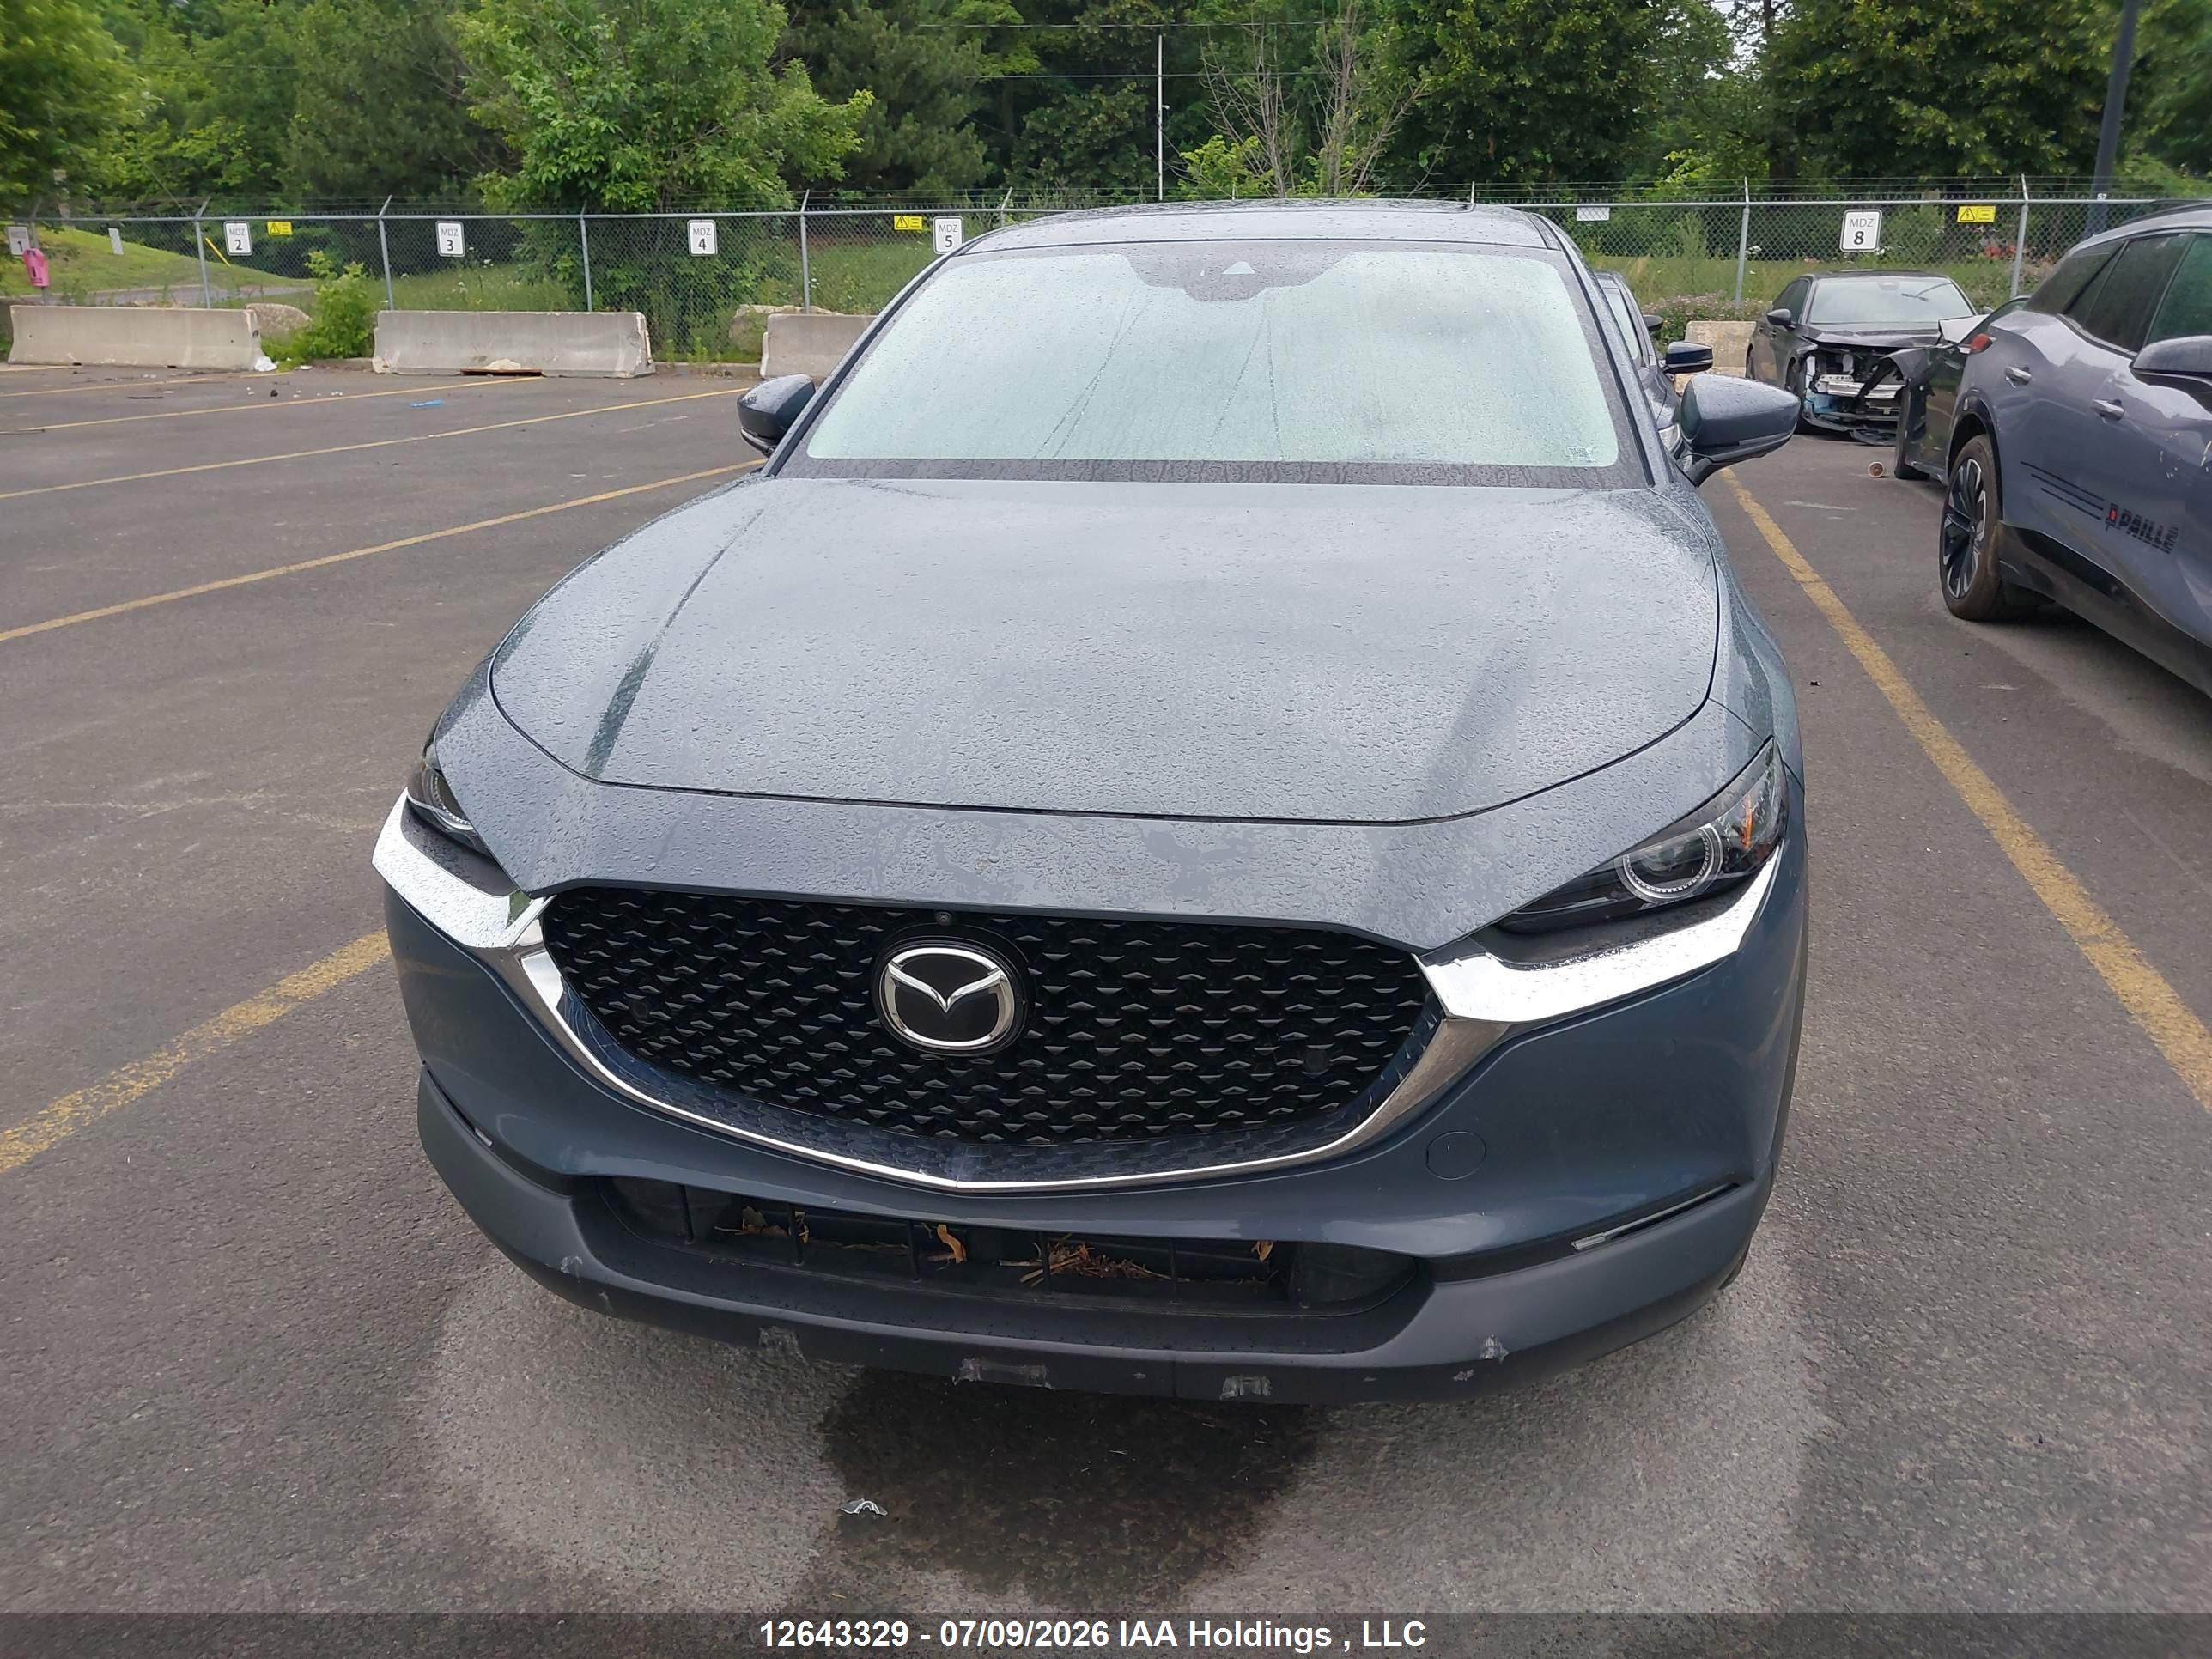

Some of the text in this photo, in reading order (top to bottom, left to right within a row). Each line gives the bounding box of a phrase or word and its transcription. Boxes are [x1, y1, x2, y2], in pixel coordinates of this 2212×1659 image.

[939, 224, 957, 233] MDZ
[1850, 218, 1875, 228] MDZ
[945, 235, 952, 247] 5
[1854, 231, 1864, 245] 8
[17, 240, 23, 252] 1
[234, 240, 242, 250] 2
[447, 240, 453, 251] 3
[698, 238, 707, 250] 4
